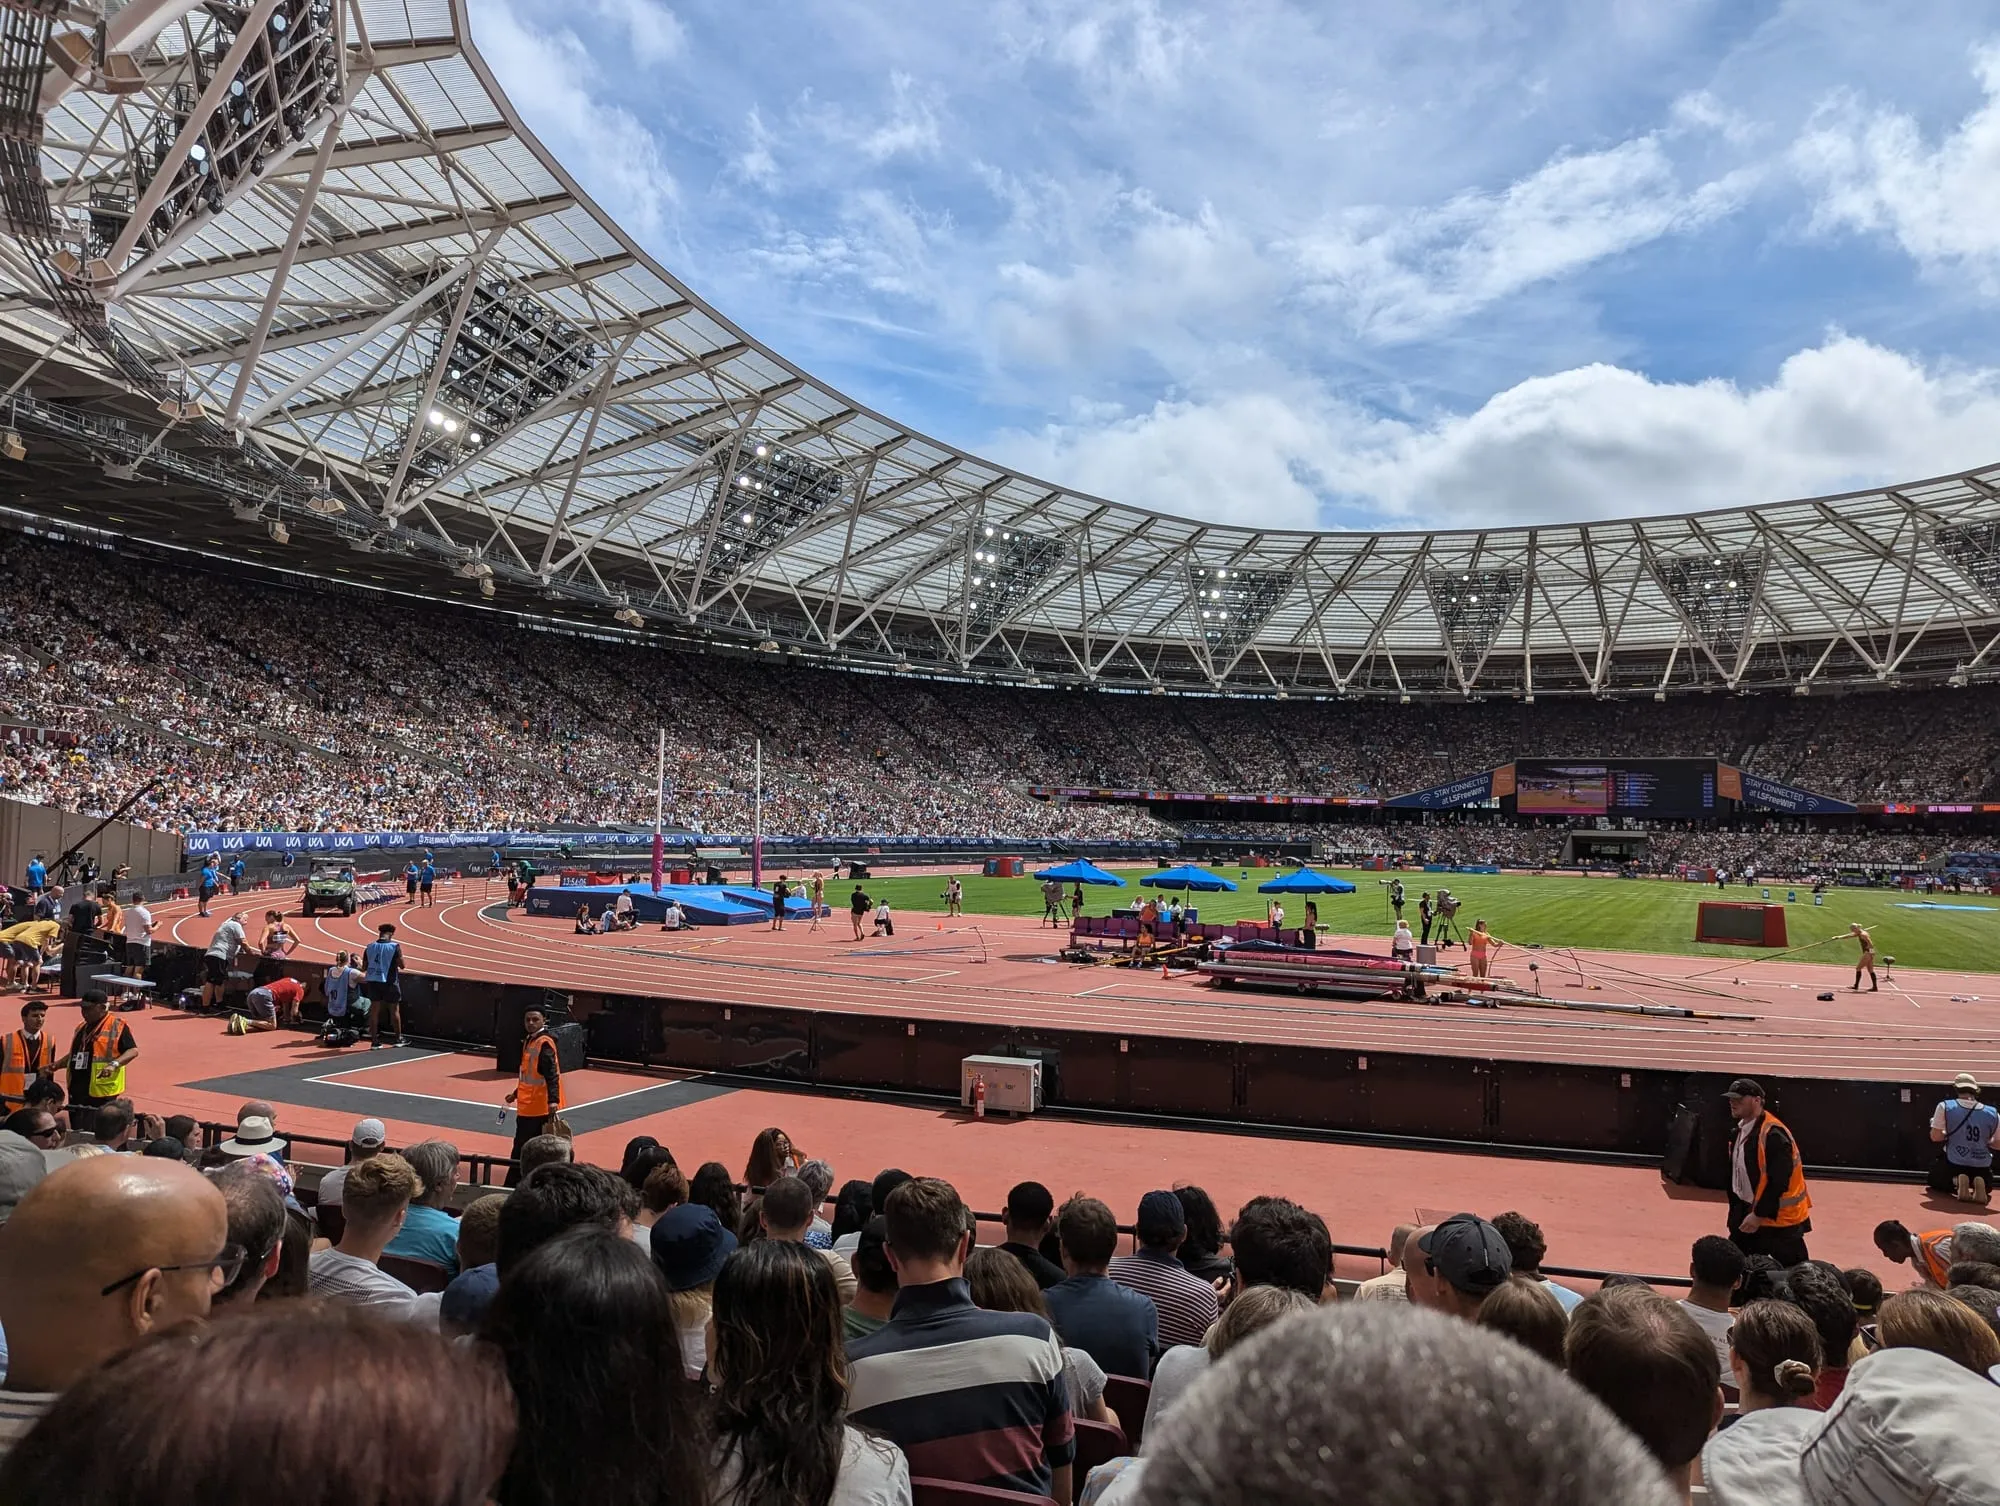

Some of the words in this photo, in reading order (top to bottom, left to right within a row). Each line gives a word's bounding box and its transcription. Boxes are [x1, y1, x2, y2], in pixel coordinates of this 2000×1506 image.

[1434, 787, 1450, 798] STAY
[1451, 776, 1488, 792] CONNECTED
[1745, 778, 1762, 788] STAY
[1762, 783, 1804, 802] CONNECTED
[189, 838, 209, 850] UKA
[223, 837, 244, 848] UKA
[256, 836, 272, 847] UKA
[286, 836, 301, 847] UKA
[309, 837, 324, 847] UKA
[335, 836, 354, 847] UKA
[364, 835, 380, 844] UKA
[1966, 1125, 1980, 1142] 39
